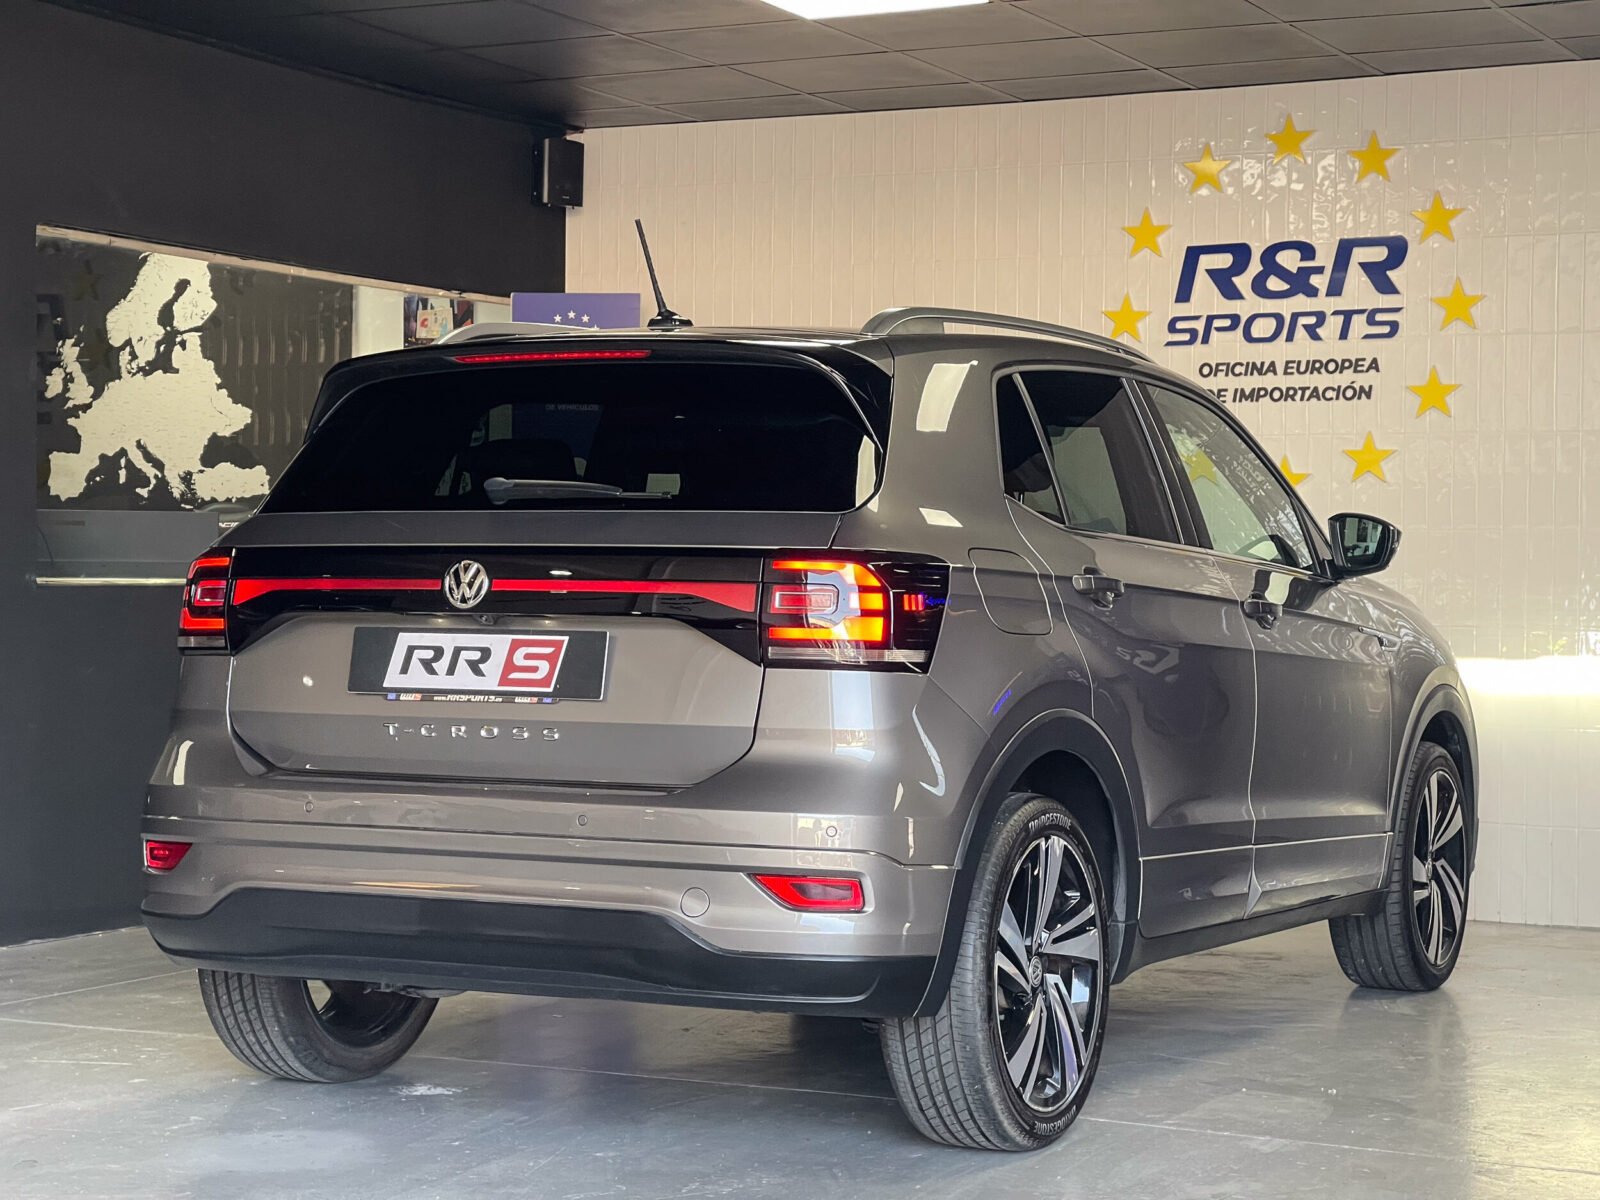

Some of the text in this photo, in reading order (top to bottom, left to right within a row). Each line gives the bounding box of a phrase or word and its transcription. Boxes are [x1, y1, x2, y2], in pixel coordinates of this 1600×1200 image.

[1174, 235, 1409, 304] R&R
[1164, 306, 1405, 347] SPORTS
[1198, 357, 1381, 379] OFICINA EUROPEA
[1231, 380, 1373, 404] IMPORTACIÓN
[383, 722, 561, 742] T-CROSS
